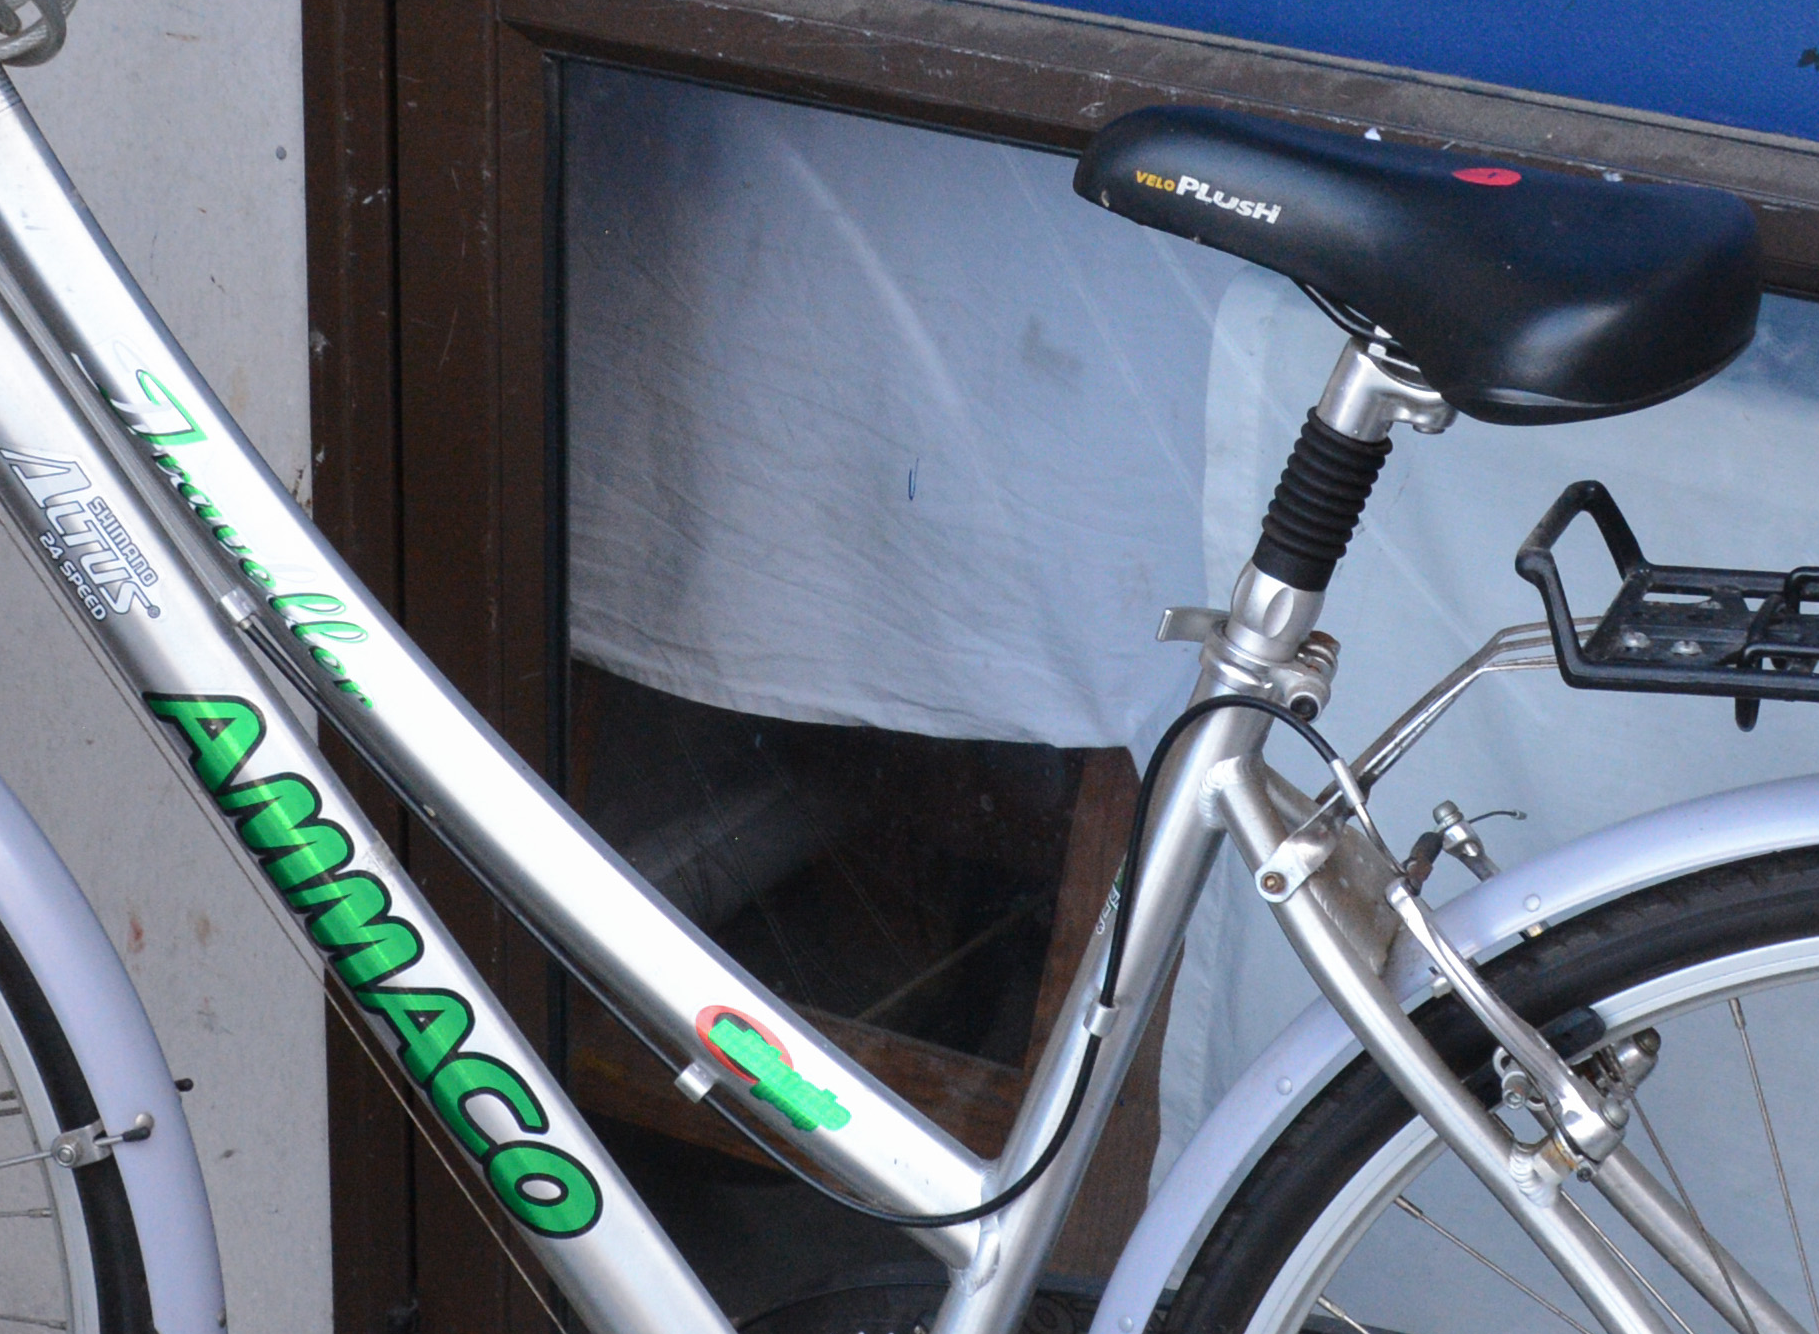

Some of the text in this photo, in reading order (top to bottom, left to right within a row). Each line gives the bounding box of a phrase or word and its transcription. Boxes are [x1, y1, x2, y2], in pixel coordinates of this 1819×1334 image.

[1136, 170, 1282, 225] VELO PLUSH
[39, 531, 108, 620] 24 SPEED
[86, 496, 158, 587] SHIMANO
[142, 691, 604, 1240] AMMACO
